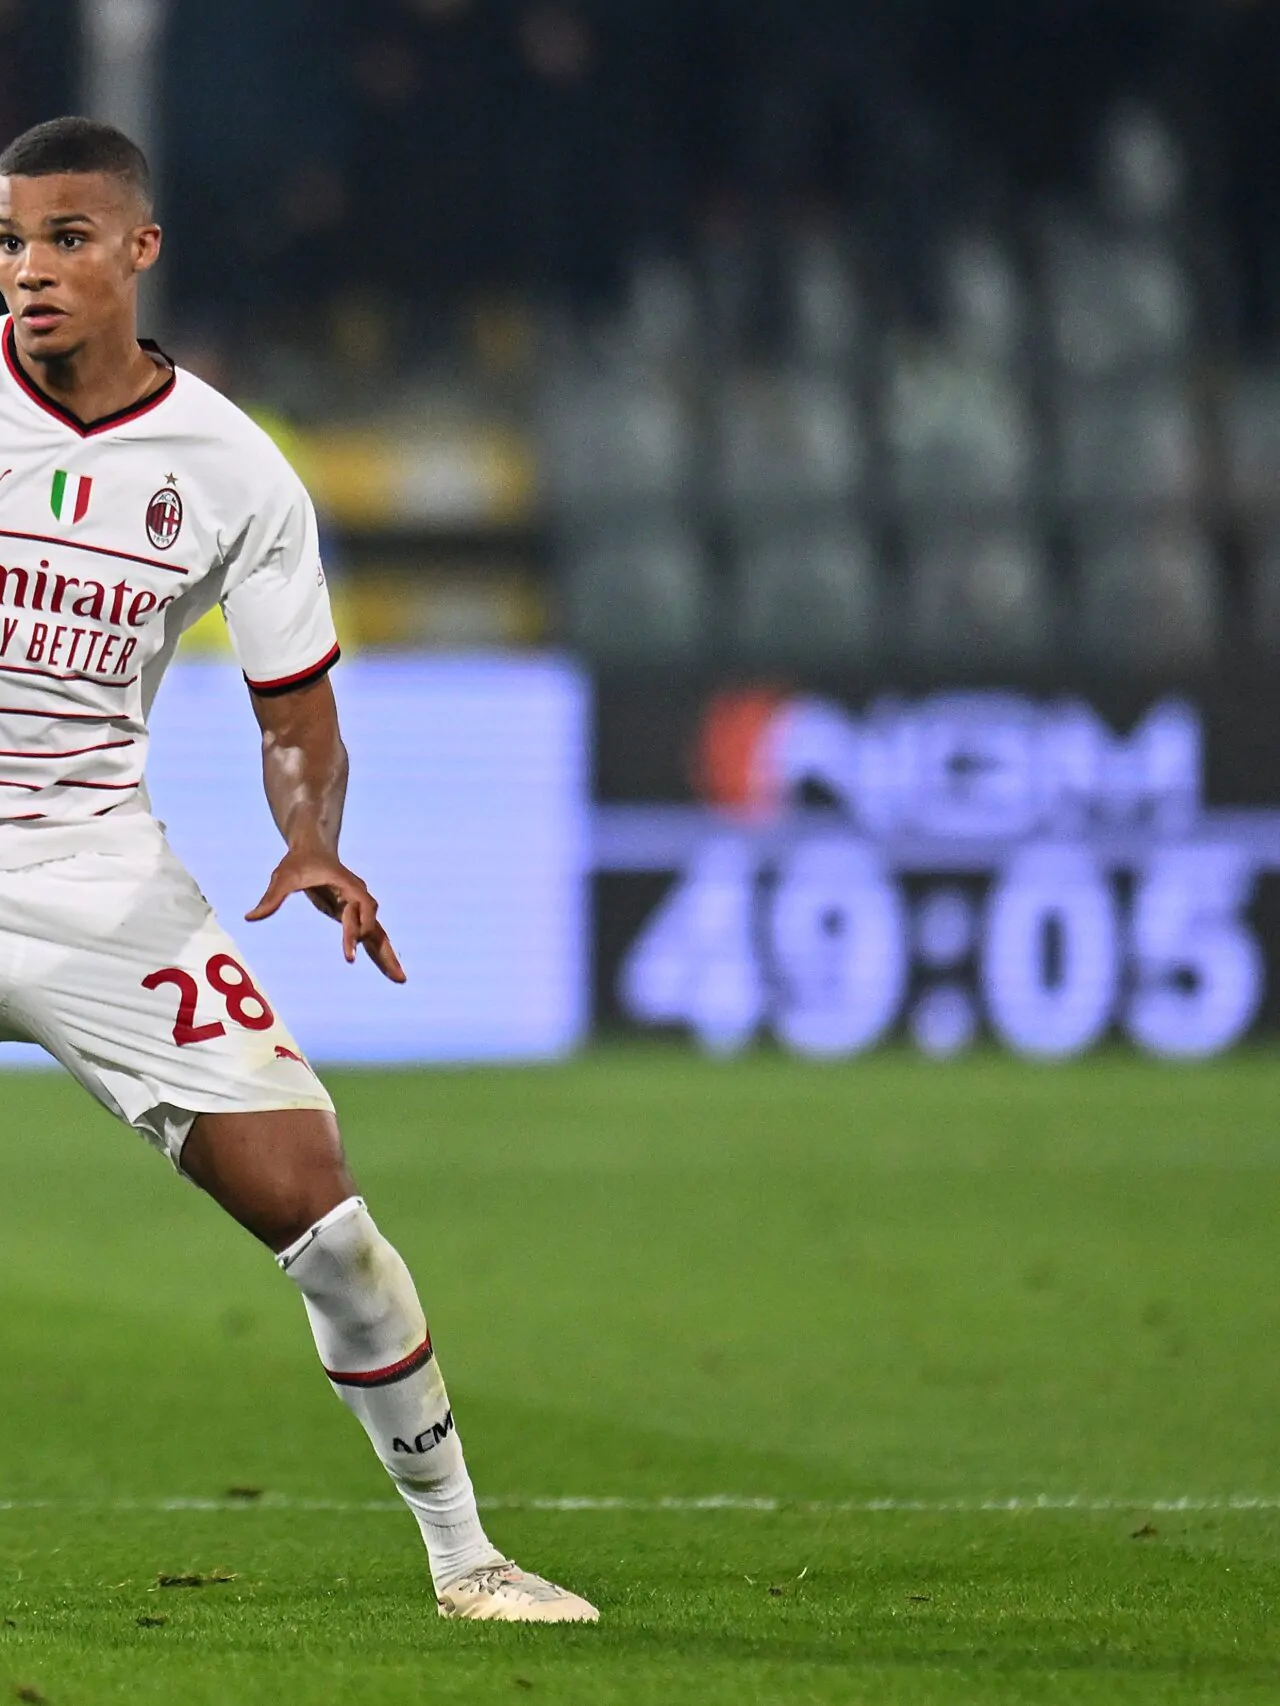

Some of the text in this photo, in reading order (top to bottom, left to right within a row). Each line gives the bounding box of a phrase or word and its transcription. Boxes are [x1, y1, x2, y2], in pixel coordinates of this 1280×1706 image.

[26, 623, 138, 675] BETTER
[623, 840, 1263, 1058] 49:05
[141, 954, 274, 1047] 28
[393, 1409, 453, 1454] ACM
